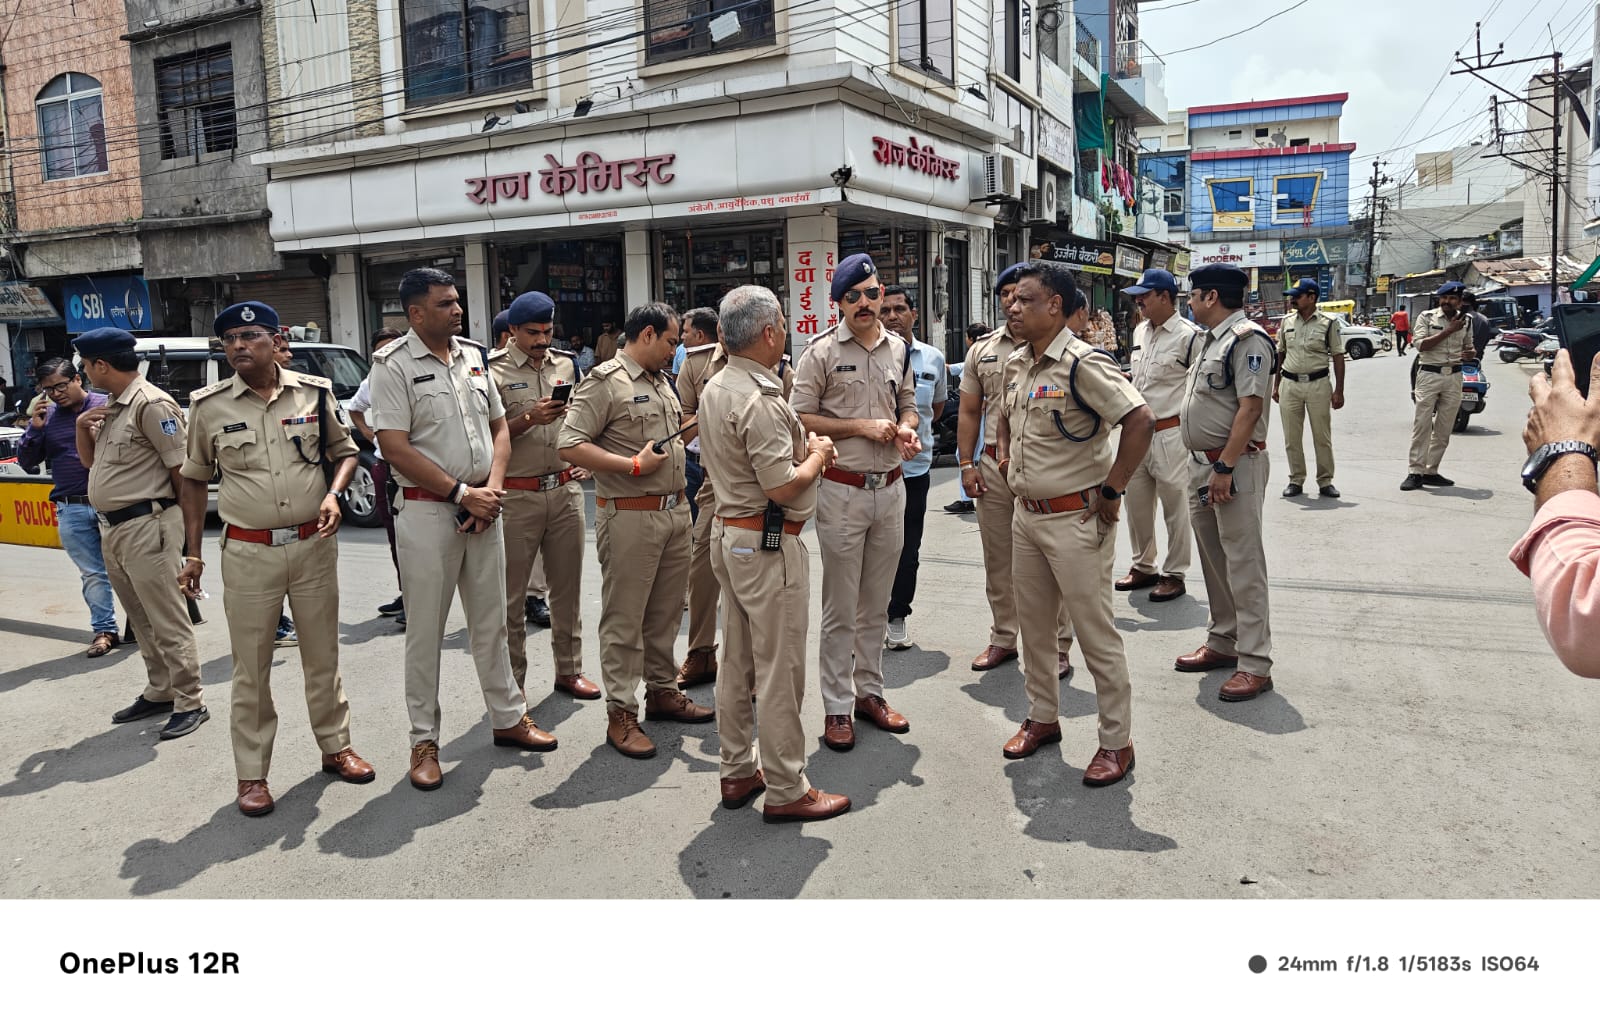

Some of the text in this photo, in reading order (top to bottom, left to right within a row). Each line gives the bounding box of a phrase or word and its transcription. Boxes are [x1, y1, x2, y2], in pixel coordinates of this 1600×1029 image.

[872, 136, 960, 182] राज केमिस्ट
[464, 151, 675, 204] राज केमिस्ट
[1203, 255, 1243, 264] MODERN
[14, 500, 59, 527] POLICE
